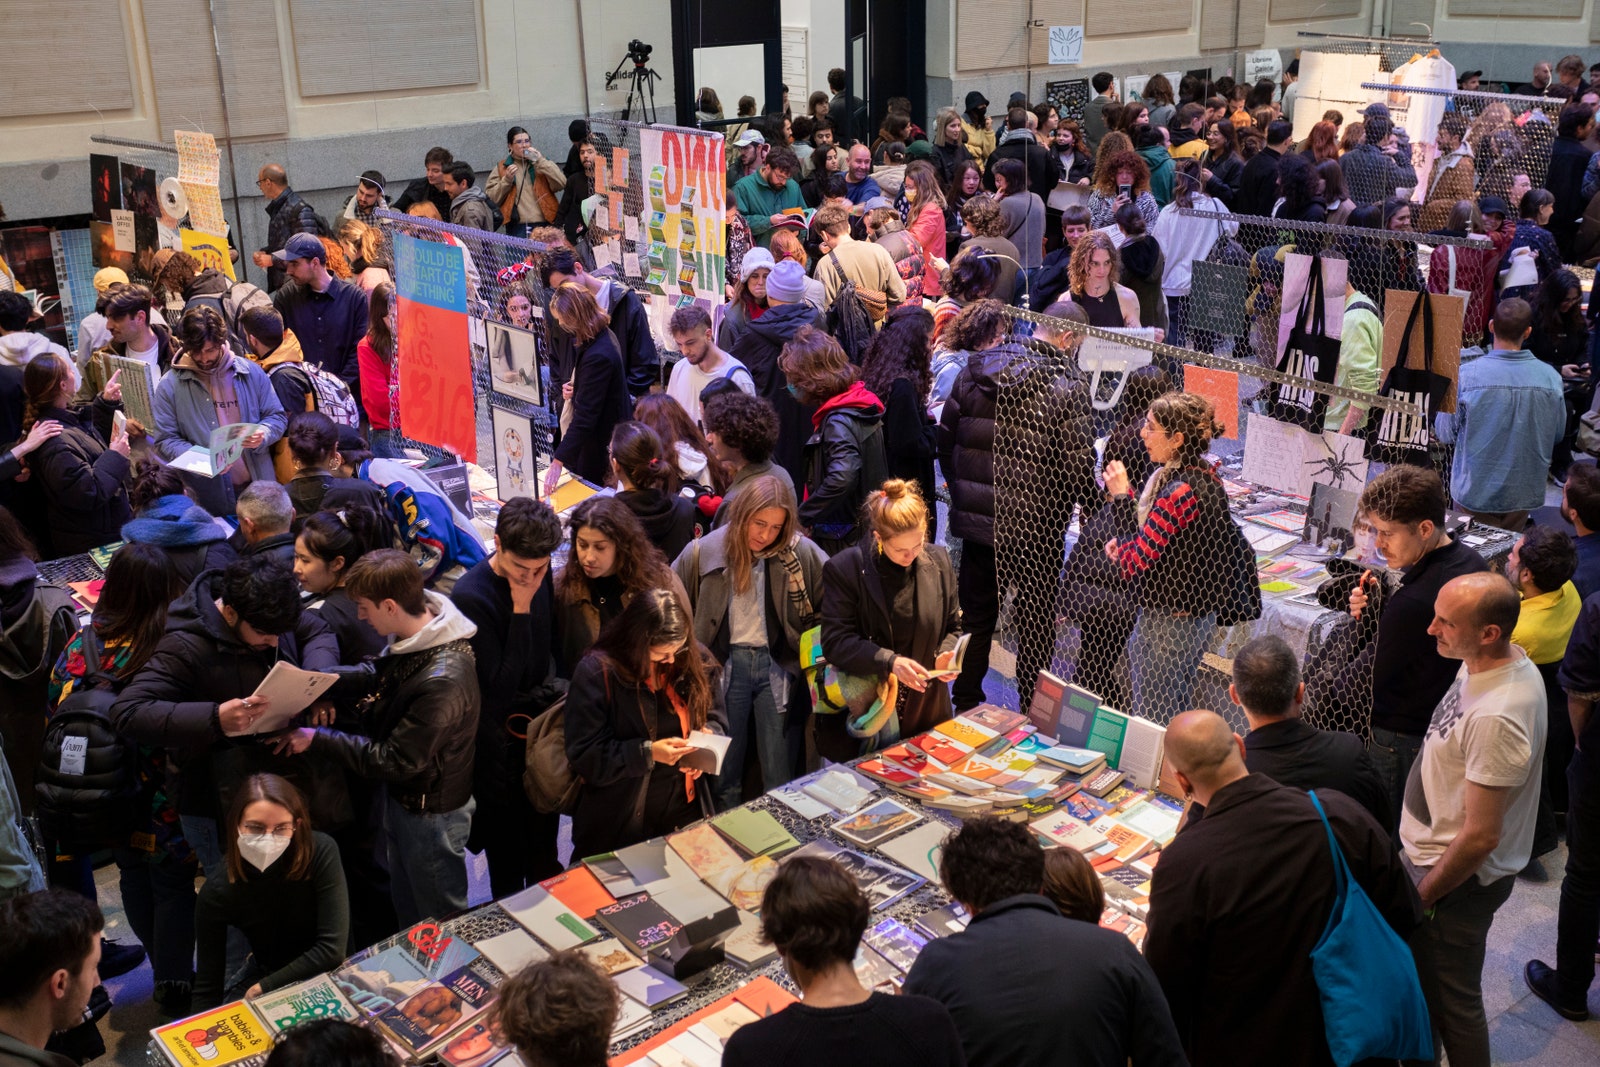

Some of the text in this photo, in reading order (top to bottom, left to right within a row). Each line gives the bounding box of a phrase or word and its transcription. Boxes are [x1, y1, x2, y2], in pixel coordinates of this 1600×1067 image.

[409, 244, 444, 267] COULD
[446, 252, 461, 270] BE
[411, 261, 441, 284] START
[443, 270, 459, 287] OF
[401, 276, 455, 304] SOMETHING
[1279, 348, 1320, 408] ATLAS
[1377, 387, 1431, 447] ATLAS
[402, 494, 418, 526] 5
[288, 986, 337, 1013] INSIEME
[453, 975, 488, 1000] MEN
[216, 1018, 246, 1051] bambies
[230, 1013, 254, 1040] babies
[249, 1038, 262, 1046] &
